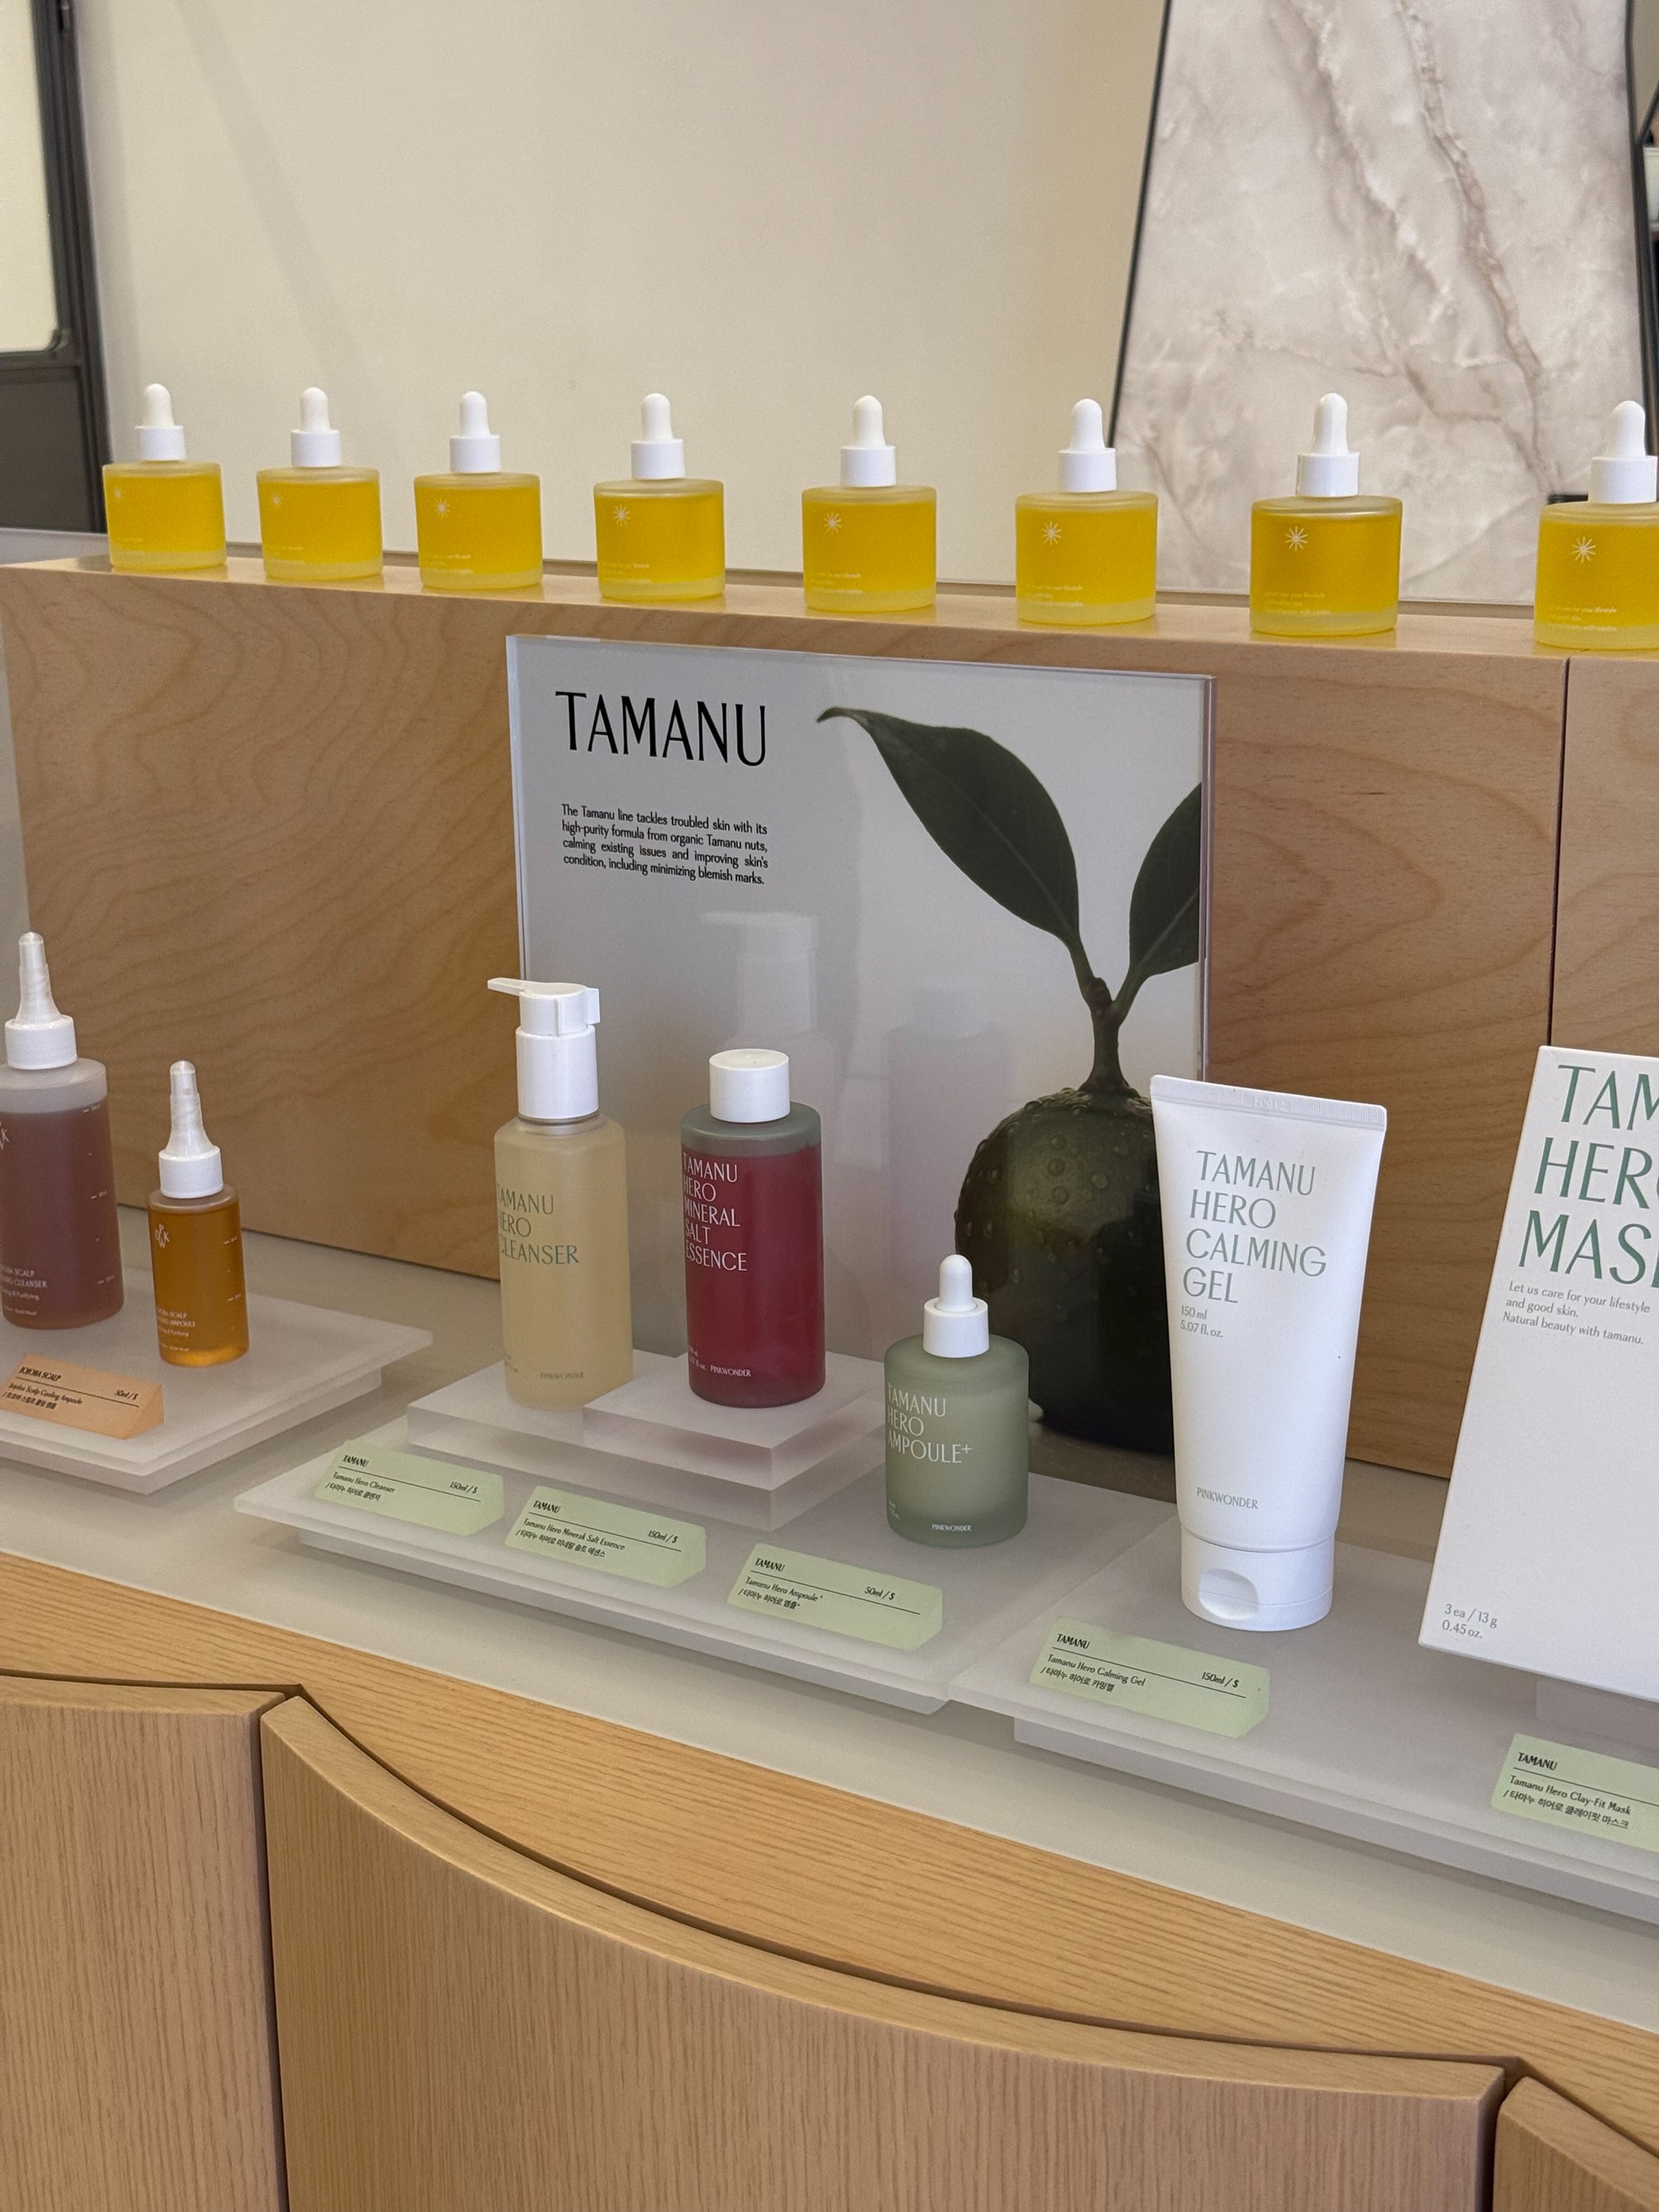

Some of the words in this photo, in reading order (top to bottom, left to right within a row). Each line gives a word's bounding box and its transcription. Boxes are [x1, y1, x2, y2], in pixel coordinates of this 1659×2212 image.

[555, 691, 766, 766] TAMANU
[562, 804, 578, 816] The
[581, 805, 615, 819] Tamanu
[618, 808, 634, 821] line
[636, 811, 668, 825] tackles
[671, 814, 709, 829] troubled
[713, 818, 730, 831] skin
[733, 820, 752, 833] with
[756, 823, 767, 834] its
[562, 819, 609, 839] high-purity
[611, 824, 645, 839] formula
[647, 828, 668, 841] from
[670, 834, 704, 847] organic
[707, 834, 742, 849] Tamanu
[745, 841, 767, 853] nuts,
[562, 836, 596, 854] calming
[601, 842, 634, 858] existing
[640, 845, 667, 858] issues
[672, 848, 688, 860] and
[694, 850, 739, 869] improving
[745, 854, 768, 868] skin's
[563, 853, 606, 869] condition,
[609, 858, 648, 876] including
[650, 863, 696, 881] minimizing
[698, 865, 732, 881] blemish
[735, 871, 764, 885] marks.
[683, 1152, 737, 1183] TAMANU
[1197, 1150, 1316, 1196] TAMANU
[1534, 1137, 1659, 1209] HER
[498, 1184, 554, 1215] AMANU
[684, 1174, 716, 1202] HERO
[684, 1196, 741, 1227] MINERAL
[1190, 1189, 1277, 1229] HERO
[685, 1218, 711, 1244] SALT
[686, 1241, 747, 1271] ESSENCE
[1186, 1228, 1326, 1276] CALMING
[1519, 1210, 1659, 1289] MAS
[13, 1279, 48, 1288] CLEANSER
[14, 1268, 35, 1277] SCALP
[1183, 1266, 1238, 1303] GEL
[1506, 1298, 1525, 1309] and
[1527, 1303, 1554, 1314] good
[1556, 1305, 1579, 1318] skin.
[1509, 1281, 1524, 1293] Let
[1541, 1289, 1564, 1300] care
[1567, 1290, 1581, 1301] for
[1584, 1296, 1607, 1306] your
[1609, 1296, 1651, 1315] lifestyle
[1181, 1305, 1195, 1318] 150
[1197, 1310, 1208, 1320] ml
[1180, 1320, 1199, 1333] 5.07
[1200, 1324, 1209, 1335] fl.
[1210, 1330, 1224, 1338] oz.
[1502, 1311, 1539, 1326] Natural
[1541, 1317, 1576, 1335] beauty
[1579, 1325, 1600, 1338] with
[1603, 1330, 1644, 1345] tamanu.
[41, 1371, 61, 1382] SCALP
[710, 1364, 752, 1377] PINKWONDER
[888, 1383, 946, 1417] TAMANU
[888, 1405, 924, 1437] HERO
[343, 1454, 369, 1467] TAMANU
[333, 1471, 354, 1483] Tamanu
[354, 1477, 369, 1487] Hero
[369, 1480, 396, 1493] Cleanser
[533, 1500, 561, 1514] TAMANU
[1197, 1486, 1258, 1510] PINKWONDER
[523, 1518, 547, 1530] Tamanu
[547, 1524, 562, 1534] Hero
[562, 1528, 586, 1540] Mineral
[586, 1534, 600, 1544] Salt
[599, 1538, 625, 1550] Essence
[648, 1529, 668, 1541] 150ml
[932, 1523, 972, 1532] PINKWONDER
[755, 1558, 786, 1573] TAMANU
[746, 1576, 771, 1590] Tamanu
[771, 1583, 788, 1594] Hero
[864, 1586, 883, 1597] 50ml
[1442, 1619, 1467, 1635] 0.45
[1467, 1629, 1482, 1639] oz.
[1444, 1603, 1452, 1615] 3
[1453, 1609, 1466, 1618] ea
[1478, 1611, 1489, 1624] 13
[1490, 1617, 1497, 1629] g
[1057, 1633, 1091, 1650] TAMANU
[1045, 1667, 1068, 1680] 타마누
[1069, 1674, 1092, 1685] 히어로
[1048, 1654, 1076, 1668] Tamanu
[1077, 1661, 1096, 1674] Hero
[1097, 1667, 1129, 1685] Calming
[1131, 1675, 1146, 1686] Gel
[1201, 1671, 1226, 1685] 150ml
[1517, 1752, 1558, 1771] TAMANU
[1510, 1775, 1544, 1792] Tamanu
[1545, 1785, 1568, 1798] Hero
[1569, 1792, 1606, 1809] Clay-Fit
[1608, 1801, 1632, 1816] Mask
[1510, 1791, 1535, 1805] 타마누
[1538, 1800, 1564, 1813] 히어로
[1564, 1805, 1602, 1821] 클레이핏
[1602, 1815, 1629, 1829] 마스크
